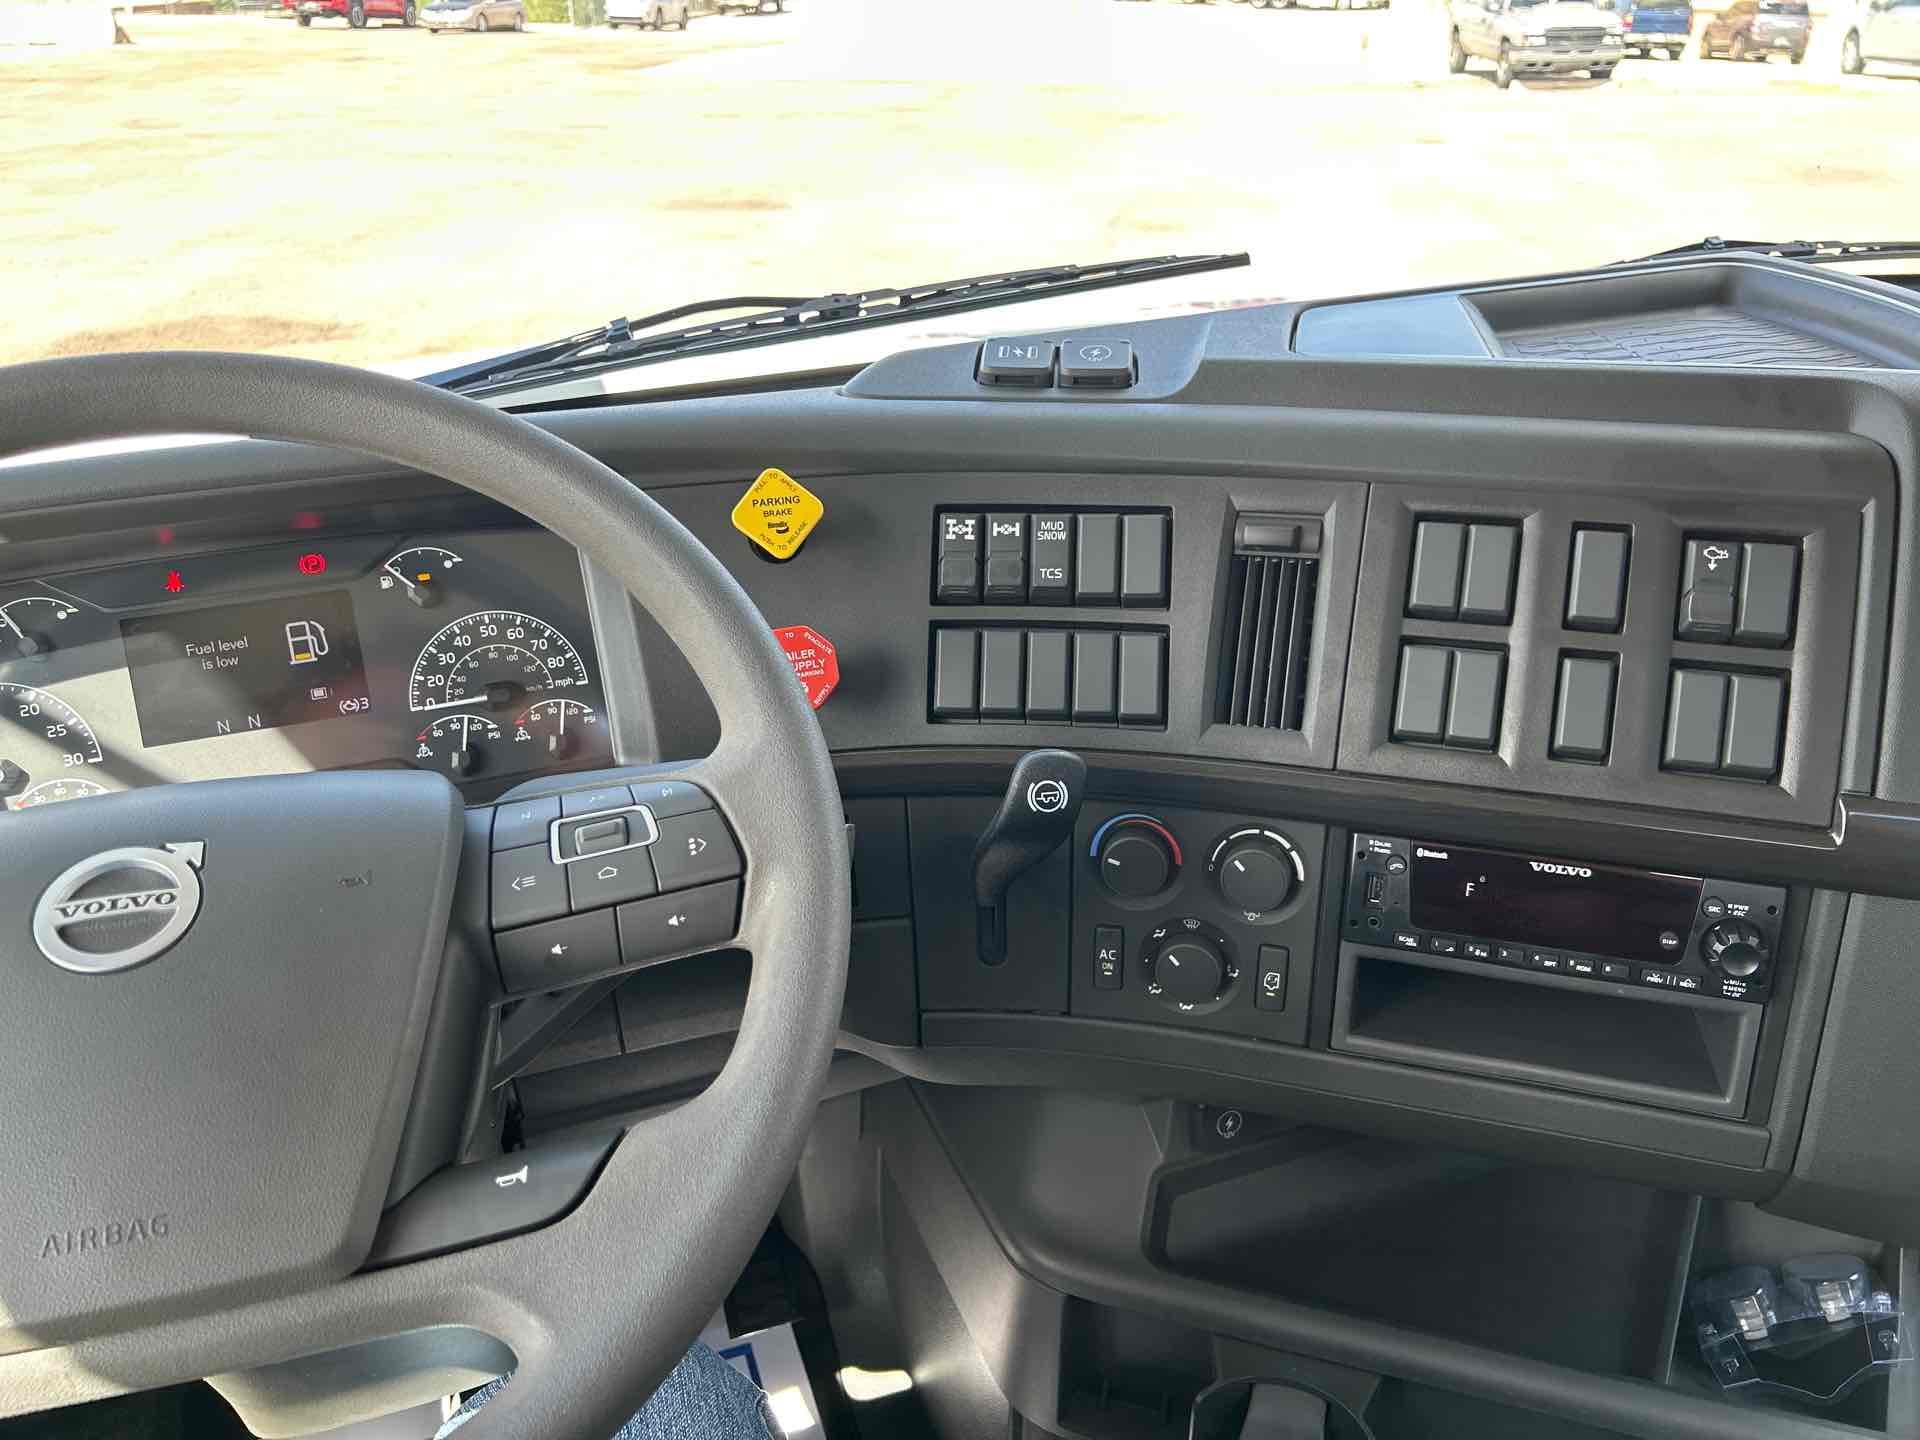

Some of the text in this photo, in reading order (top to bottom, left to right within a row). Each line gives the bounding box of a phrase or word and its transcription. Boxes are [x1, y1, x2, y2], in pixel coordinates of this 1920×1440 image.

[752, 495, 801, 508] PARKING
[763, 508, 793, 518] BRAKE
[1040, 520, 1065, 531] MUD
[1037, 530, 1067, 541] SNOW
[1039, 568, 1063, 579] TCS
[479, 624, 498, 638] 50
[506, 627, 525, 640] 60
[185, 636, 249, 657] Fuel level
[453, 635, 472, 648] 40
[530, 638, 548, 651] 70
[201, 655, 239, 671] is low
[437, 652, 456, 665] 30
[506, 654, 519, 662] 100
[547, 656, 565, 668] 80
[792, 658, 825, 672] UPPLY
[427, 674, 445, 687] 20
[456, 675, 467, 683] 40
[555, 677, 575, 688] mph
[453, 688, 465, 696] 20
[20, 703, 40, 717] 20
[359, 697, 370, 710] 3
[566, 706, 579, 715] 120
[216, 714, 262, 734] N N
[470, 723, 483, 731] 120
[46, 724, 67, 738] 25
[63, 752, 84, 768] 30
[1529, 861, 1592, 878] VOLVO
[56, 891, 177, 918] VOLVO
[1707, 905, 1721, 913] SRC
[1099, 949, 1117, 960] AC
[1646, 975, 1664, 984] PREV
[41, 1213, 169, 1258] AIRBAG
